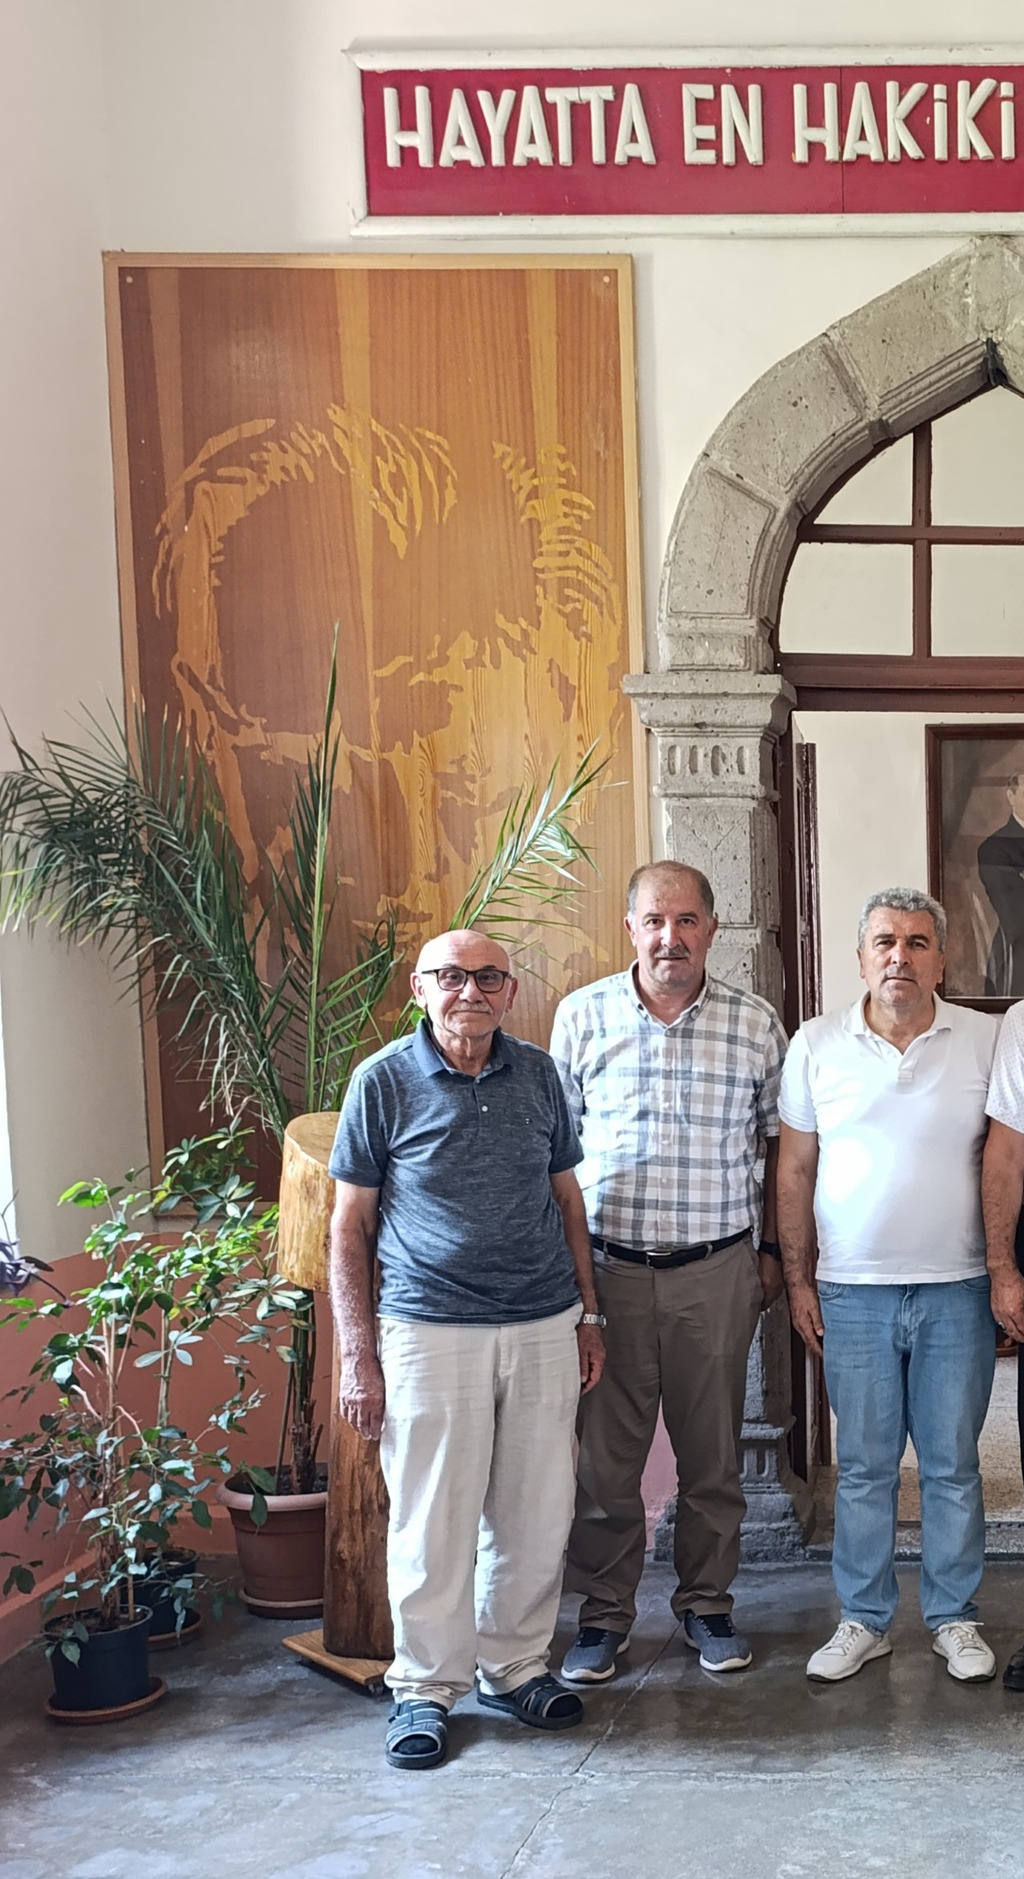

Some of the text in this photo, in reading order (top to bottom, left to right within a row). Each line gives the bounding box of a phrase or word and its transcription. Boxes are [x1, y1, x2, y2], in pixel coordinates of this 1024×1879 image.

[383, 83, 657, 168] HAYATTA
[681, 82, 764, 166] EN
[792, 78, 1015, 164] HAKİKİ
